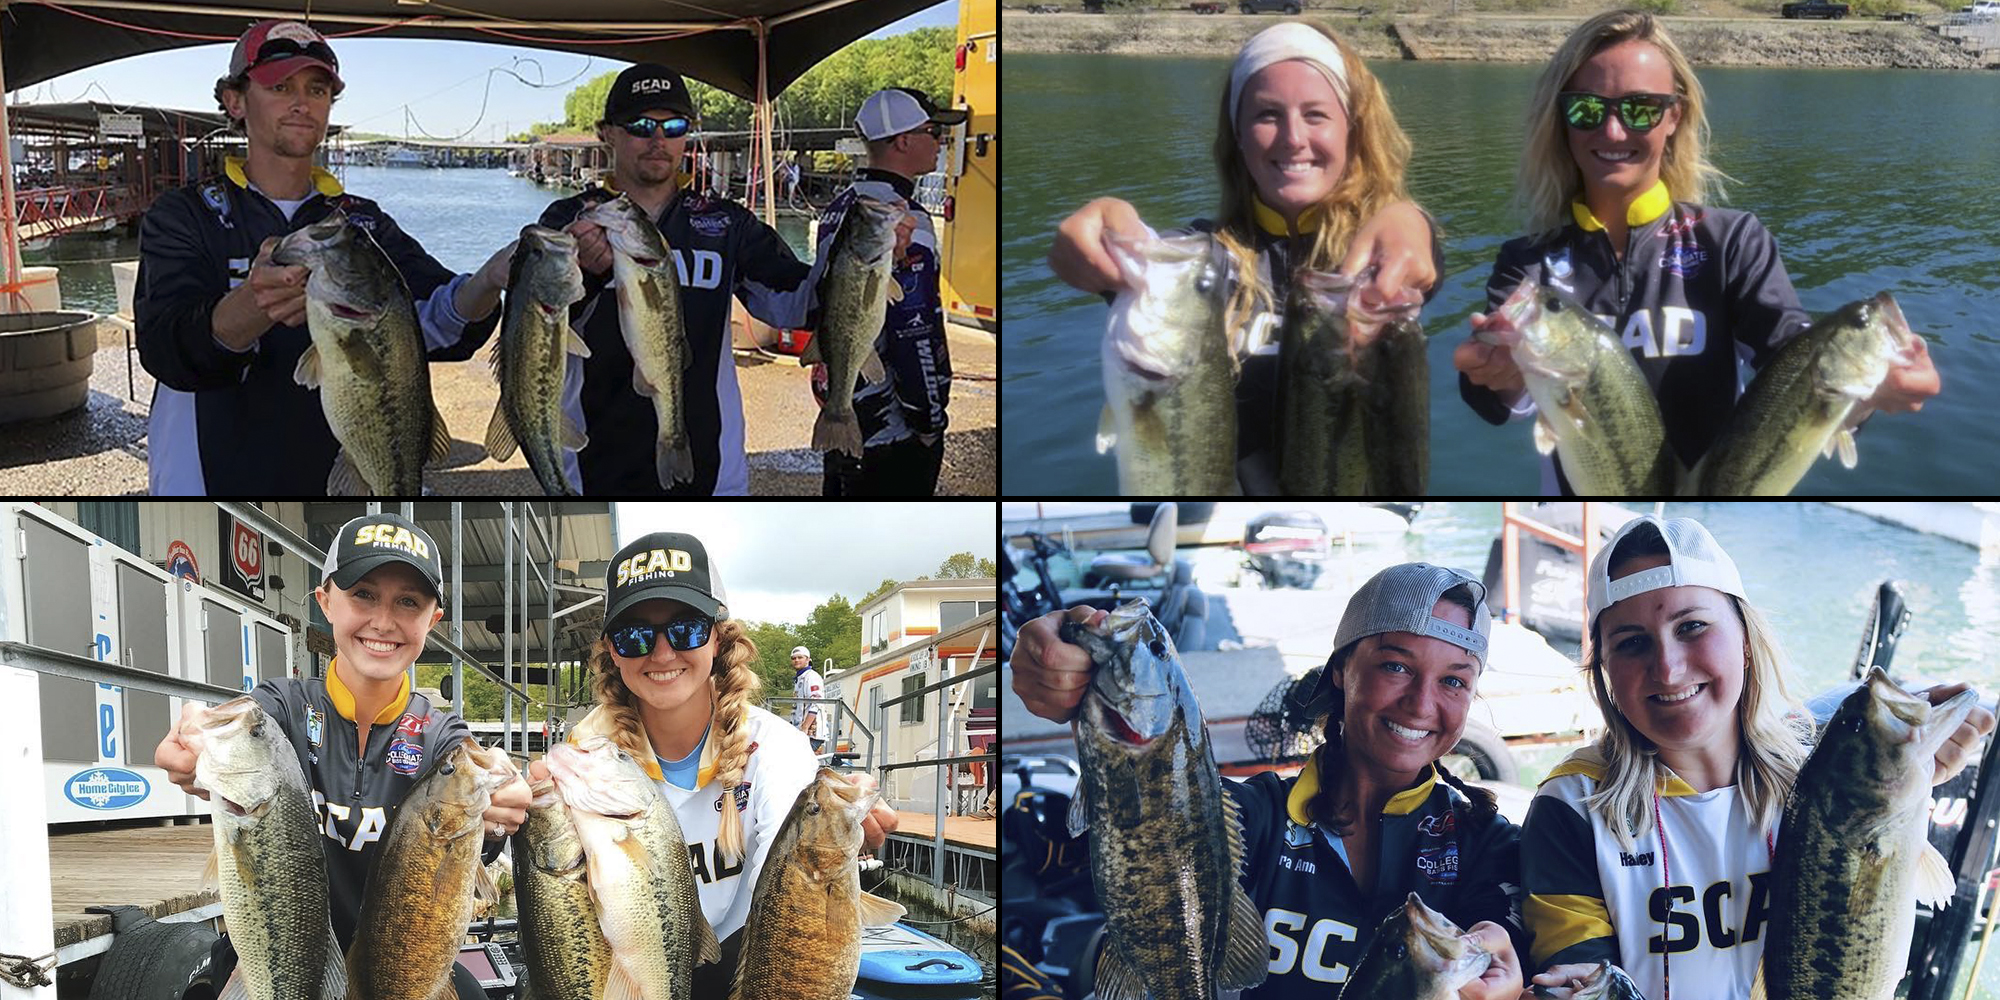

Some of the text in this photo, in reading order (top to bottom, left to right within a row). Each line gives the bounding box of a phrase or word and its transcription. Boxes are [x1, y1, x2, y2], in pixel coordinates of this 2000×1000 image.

[632, 79, 671, 93] SCAD
[1594, 306, 1707, 359] AD
[238, 532, 258, 567] 66
[354, 523, 430, 560] SCAD
[372, 540, 418, 557] FISHING
[616, 548, 693, 588] SCAD
[628, 569, 675, 586] FISHING
[78, 783, 140, 795] Home City Ice
[688, 837, 747, 884] AD
[1278, 854, 1316, 875] ra Ann
[1417, 856, 1459, 869] COLLEG
[1648, 870, 1772, 954] SCA
[1263, 908, 1358, 983] SC
